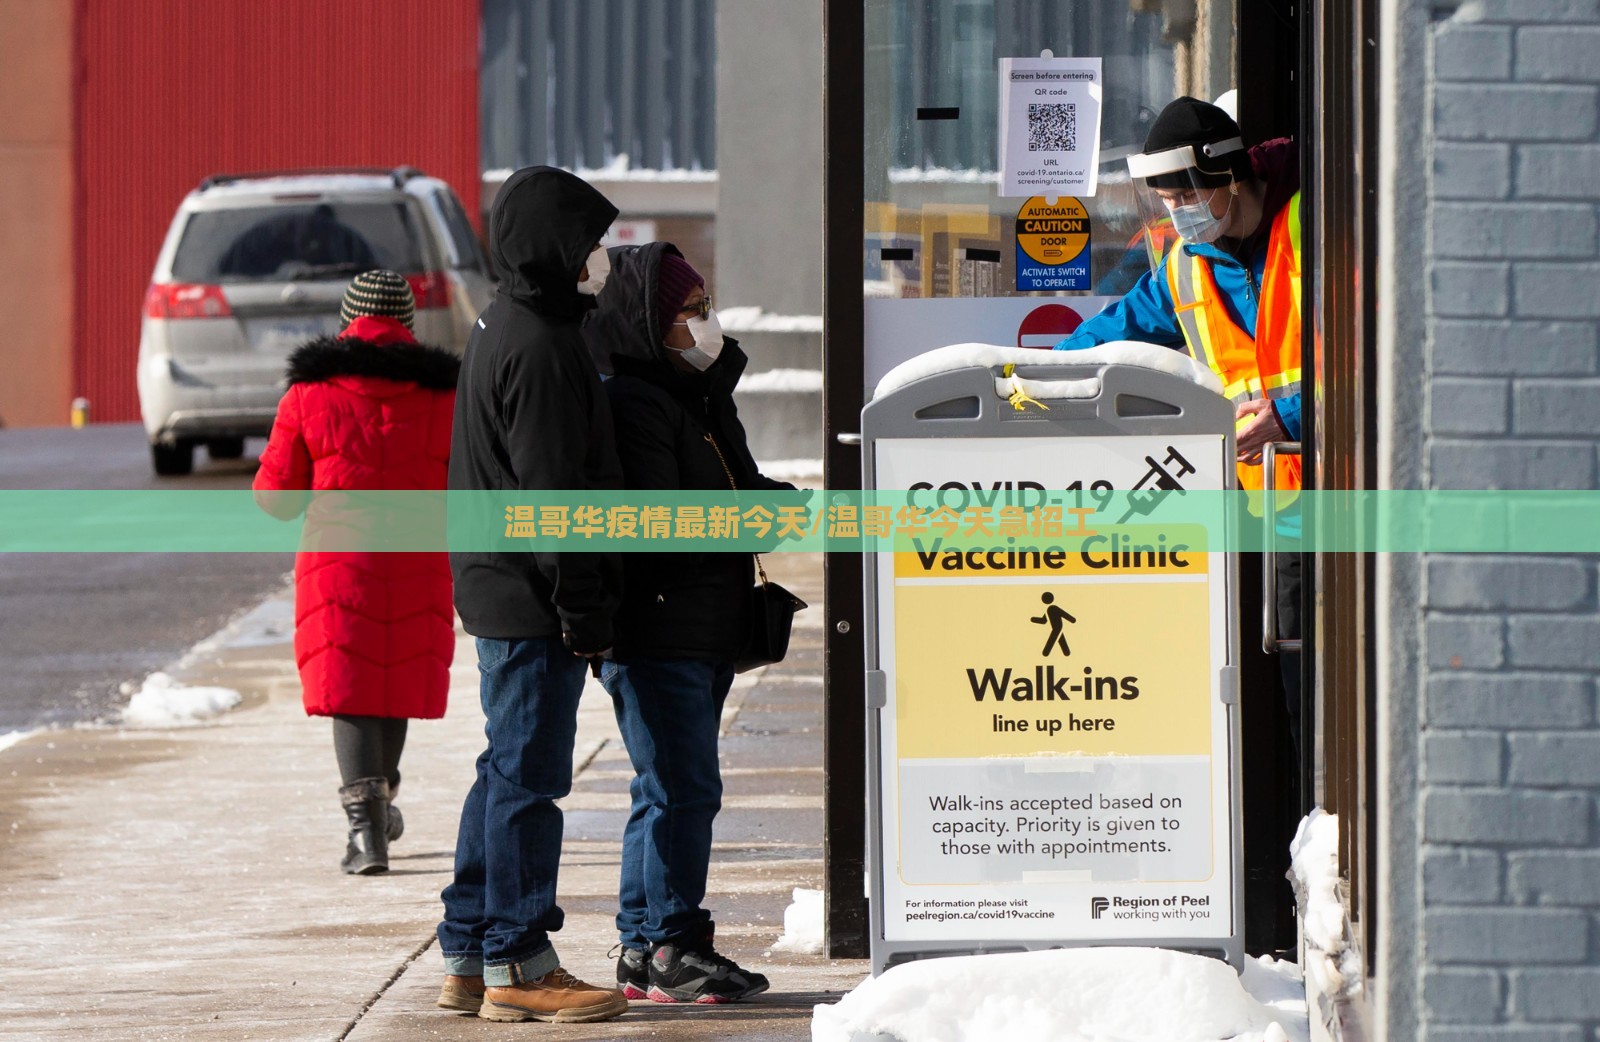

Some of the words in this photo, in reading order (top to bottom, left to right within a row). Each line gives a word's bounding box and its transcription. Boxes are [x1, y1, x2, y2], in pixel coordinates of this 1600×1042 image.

[1010, 72, 1034, 80] Screen
[1035, 72, 1061, 80] before
[1062, 72, 1094, 81] entering
[1034, 88, 1047, 96] QR
[1049, 88, 1068, 96] code
[1017, 168, 1085, 176] covid-19.ontario.ca/
[1017, 177, 1084, 186] screening/customer
[1027, 207, 1079, 216] AUTOMATIC
[1024, 220, 1083, 233] CAUTION
[1040, 237, 1067, 246] DOOR
[1021, 267, 1056, 277] ACTIVATE
[1058, 267, 1086, 276] SWITCH
[1031, 278, 1043, 287] TO
[1044, 278, 1076, 287] OPERATE
[906, 480, 1114, 514] COVID-19
[912, 533, 1068, 570] Vaccine
[1080, 533, 1190, 569] Clinic
[966, 665, 1140, 702] Walk-ins
[992, 714, 1029, 732] line
[1036, 719, 1062, 737] up
[1069, 713, 1116, 732] here
[928, 795, 1004, 812] Walk-ins
[1009, 794, 1093, 815] accepted
[1099, 793, 1153, 811] based
[1159, 796, 1182, 809] on
[932, 816, 1010, 836] capacity.
[1016, 816, 1081, 836] Priority
[1087, 815, 1101, 832] is
[1106, 816, 1156, 835] given
[1160, 816, 1180, 831] to
[940, 839, 991, 855] those
[997, 838, 1035, 855] with
[1041, 837, 1172, 859] appointments.
[905, 899, 921, 908] For
[923, 899, 976, 908] information
[978, 899, 1007, 911] please
[1009, 898, 1028, 907] visit
[1112, 896, 1160, 910] Region
[1162, 895, 1177, 907] of
[1180, 895, 1210, 907] Peel
[905, 909, 1055, 922] peelregion.ca/covid19vaccine
[1112, 908, 1160, 922] working
[1161, 908, 1187, 919] with
[1188, 910, 1211, 921] you
